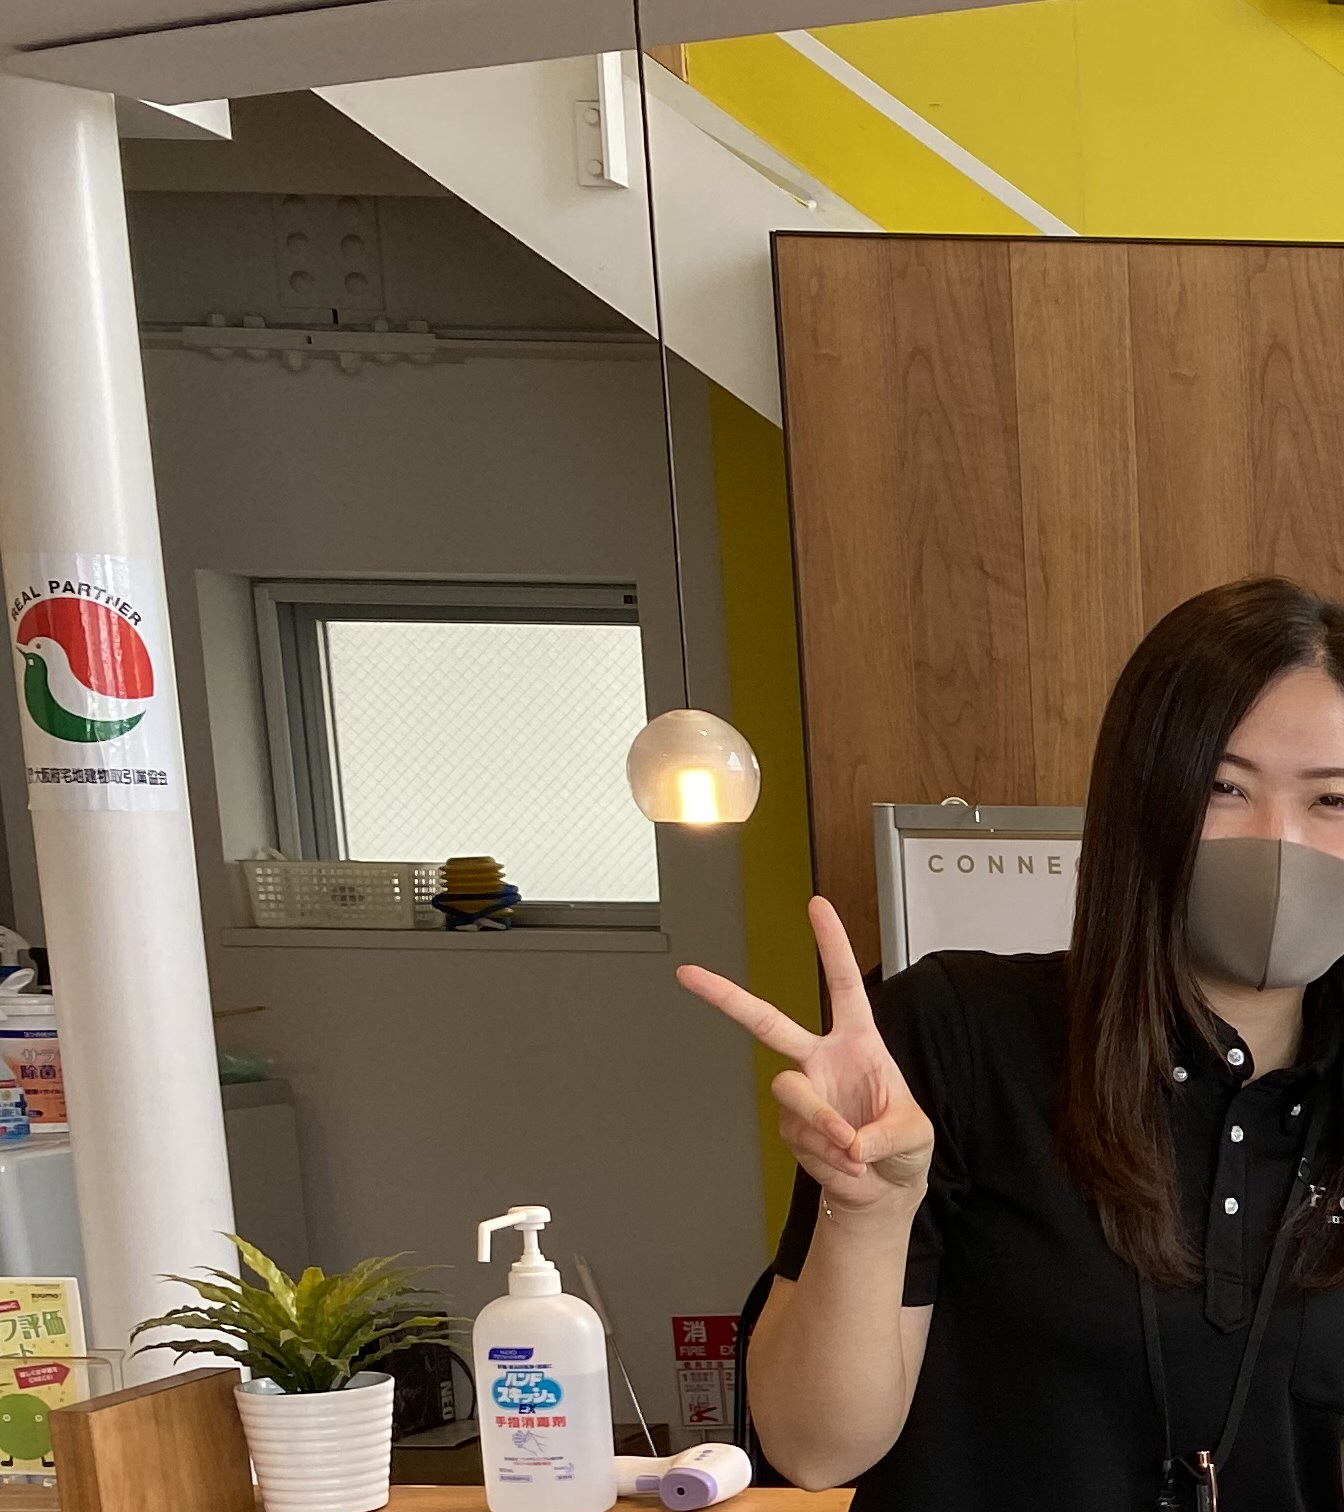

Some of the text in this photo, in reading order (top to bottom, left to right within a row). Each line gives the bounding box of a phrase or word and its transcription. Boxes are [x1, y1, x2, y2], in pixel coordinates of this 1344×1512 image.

[11, 580, 142, 626] REAL PARTNER
[927, 854, 1081, 875] CONNE
[679, 1345, 708, 1357] FIRE
[518, 1403, 538, 1415] EX
